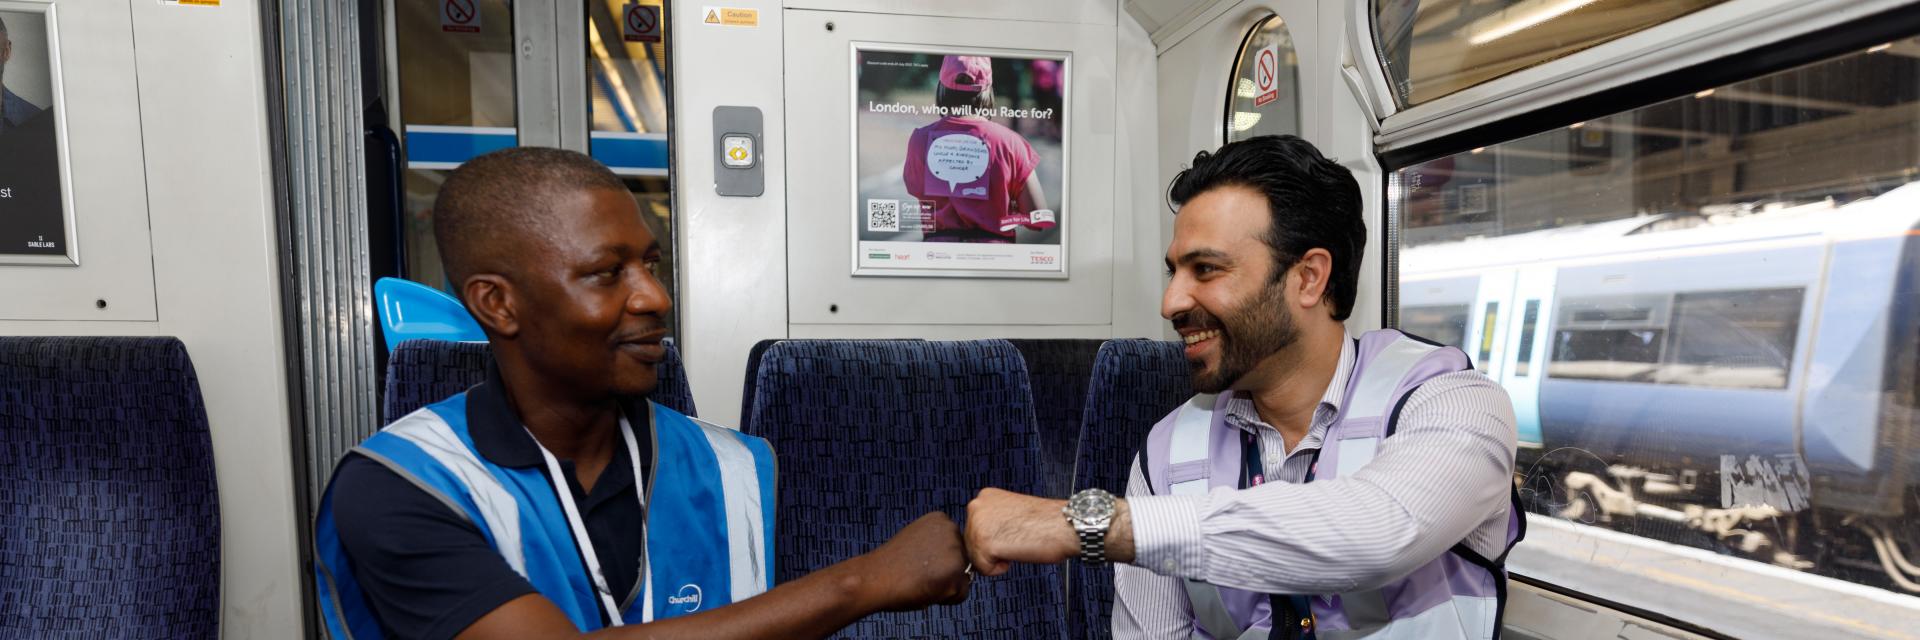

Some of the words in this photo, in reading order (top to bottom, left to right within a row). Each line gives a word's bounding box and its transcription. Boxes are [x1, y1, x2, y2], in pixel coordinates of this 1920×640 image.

[869, 101, 919, 115] London,
[922, 105, 949, 116] who
[951, 105, 973, 117] will
[974, 108, 997, 118] you
[1000, 106, 1028, 118] Race
[1030, 107, 1053, 119] for?
[668, 594, 698, 604] Churchill
